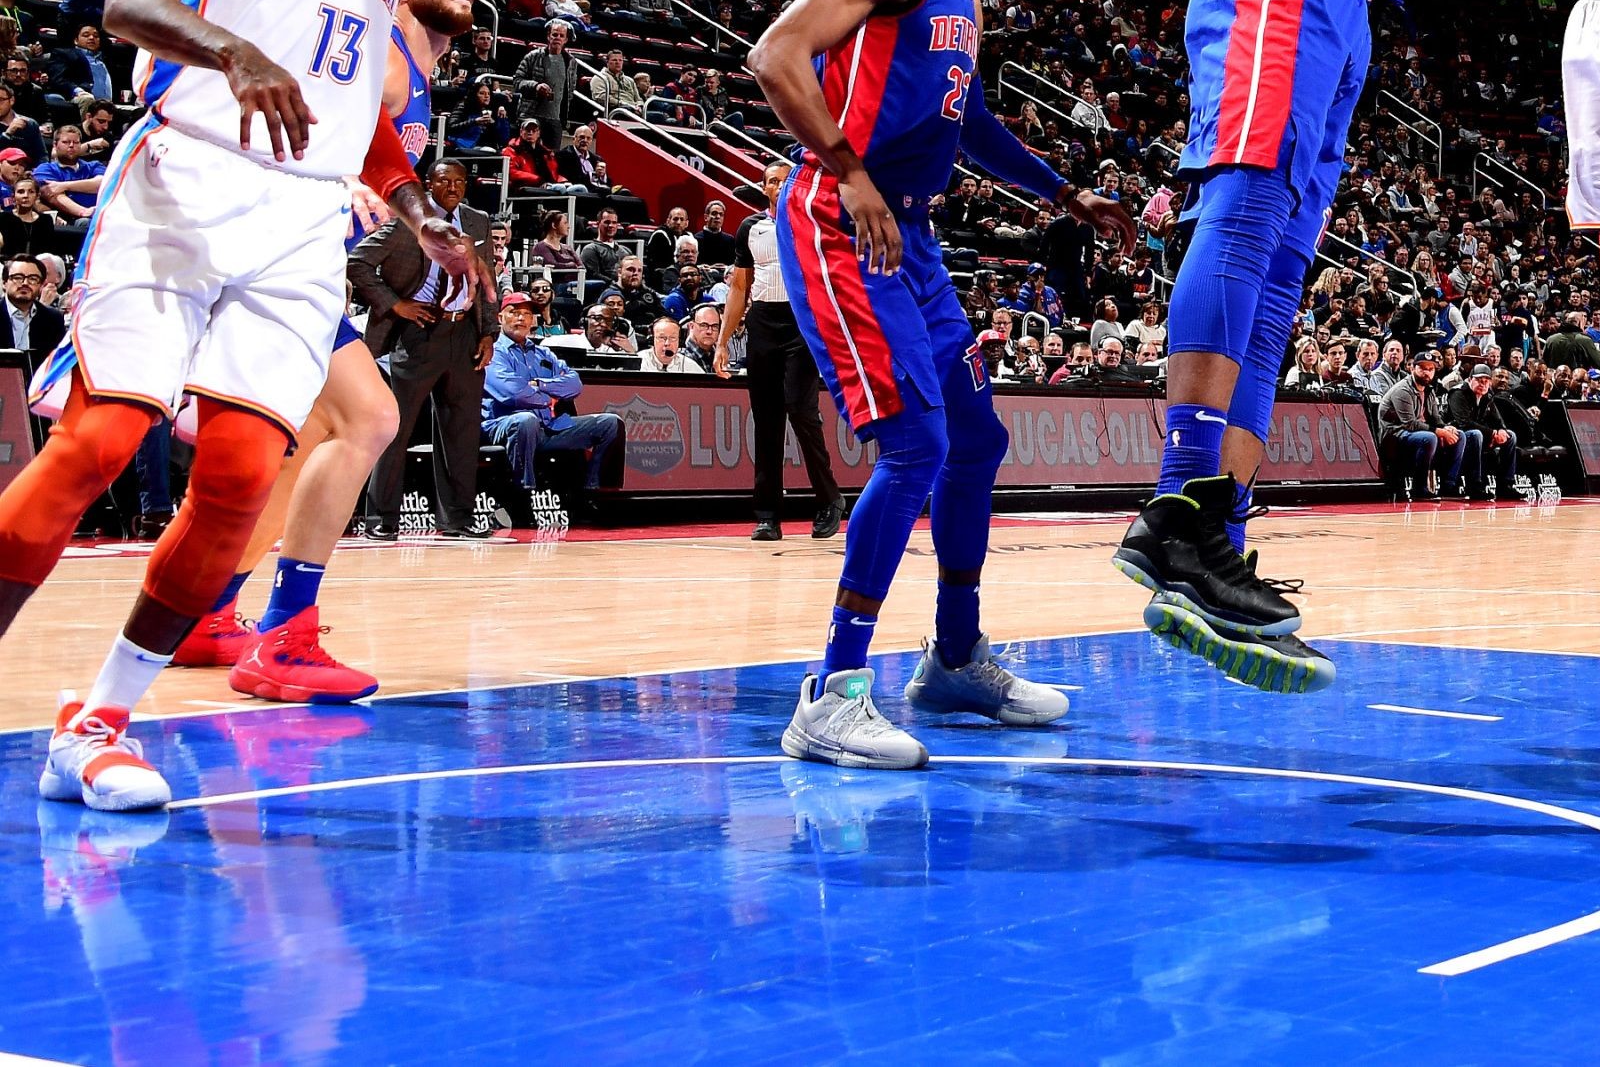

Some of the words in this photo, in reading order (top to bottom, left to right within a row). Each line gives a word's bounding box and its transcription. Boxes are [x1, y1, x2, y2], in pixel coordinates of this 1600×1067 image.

[308, 2, 369, 85] 13
[626, 421, 674, 442] UCAS
[690, 404, 801, 467] LUA
[1108, 412, 1158, 465] OIL
[1265, 415, 1313, 464] CAS
[1319, 416, 1360, 463] OIL
[532, 489, 560, 510] ittle
